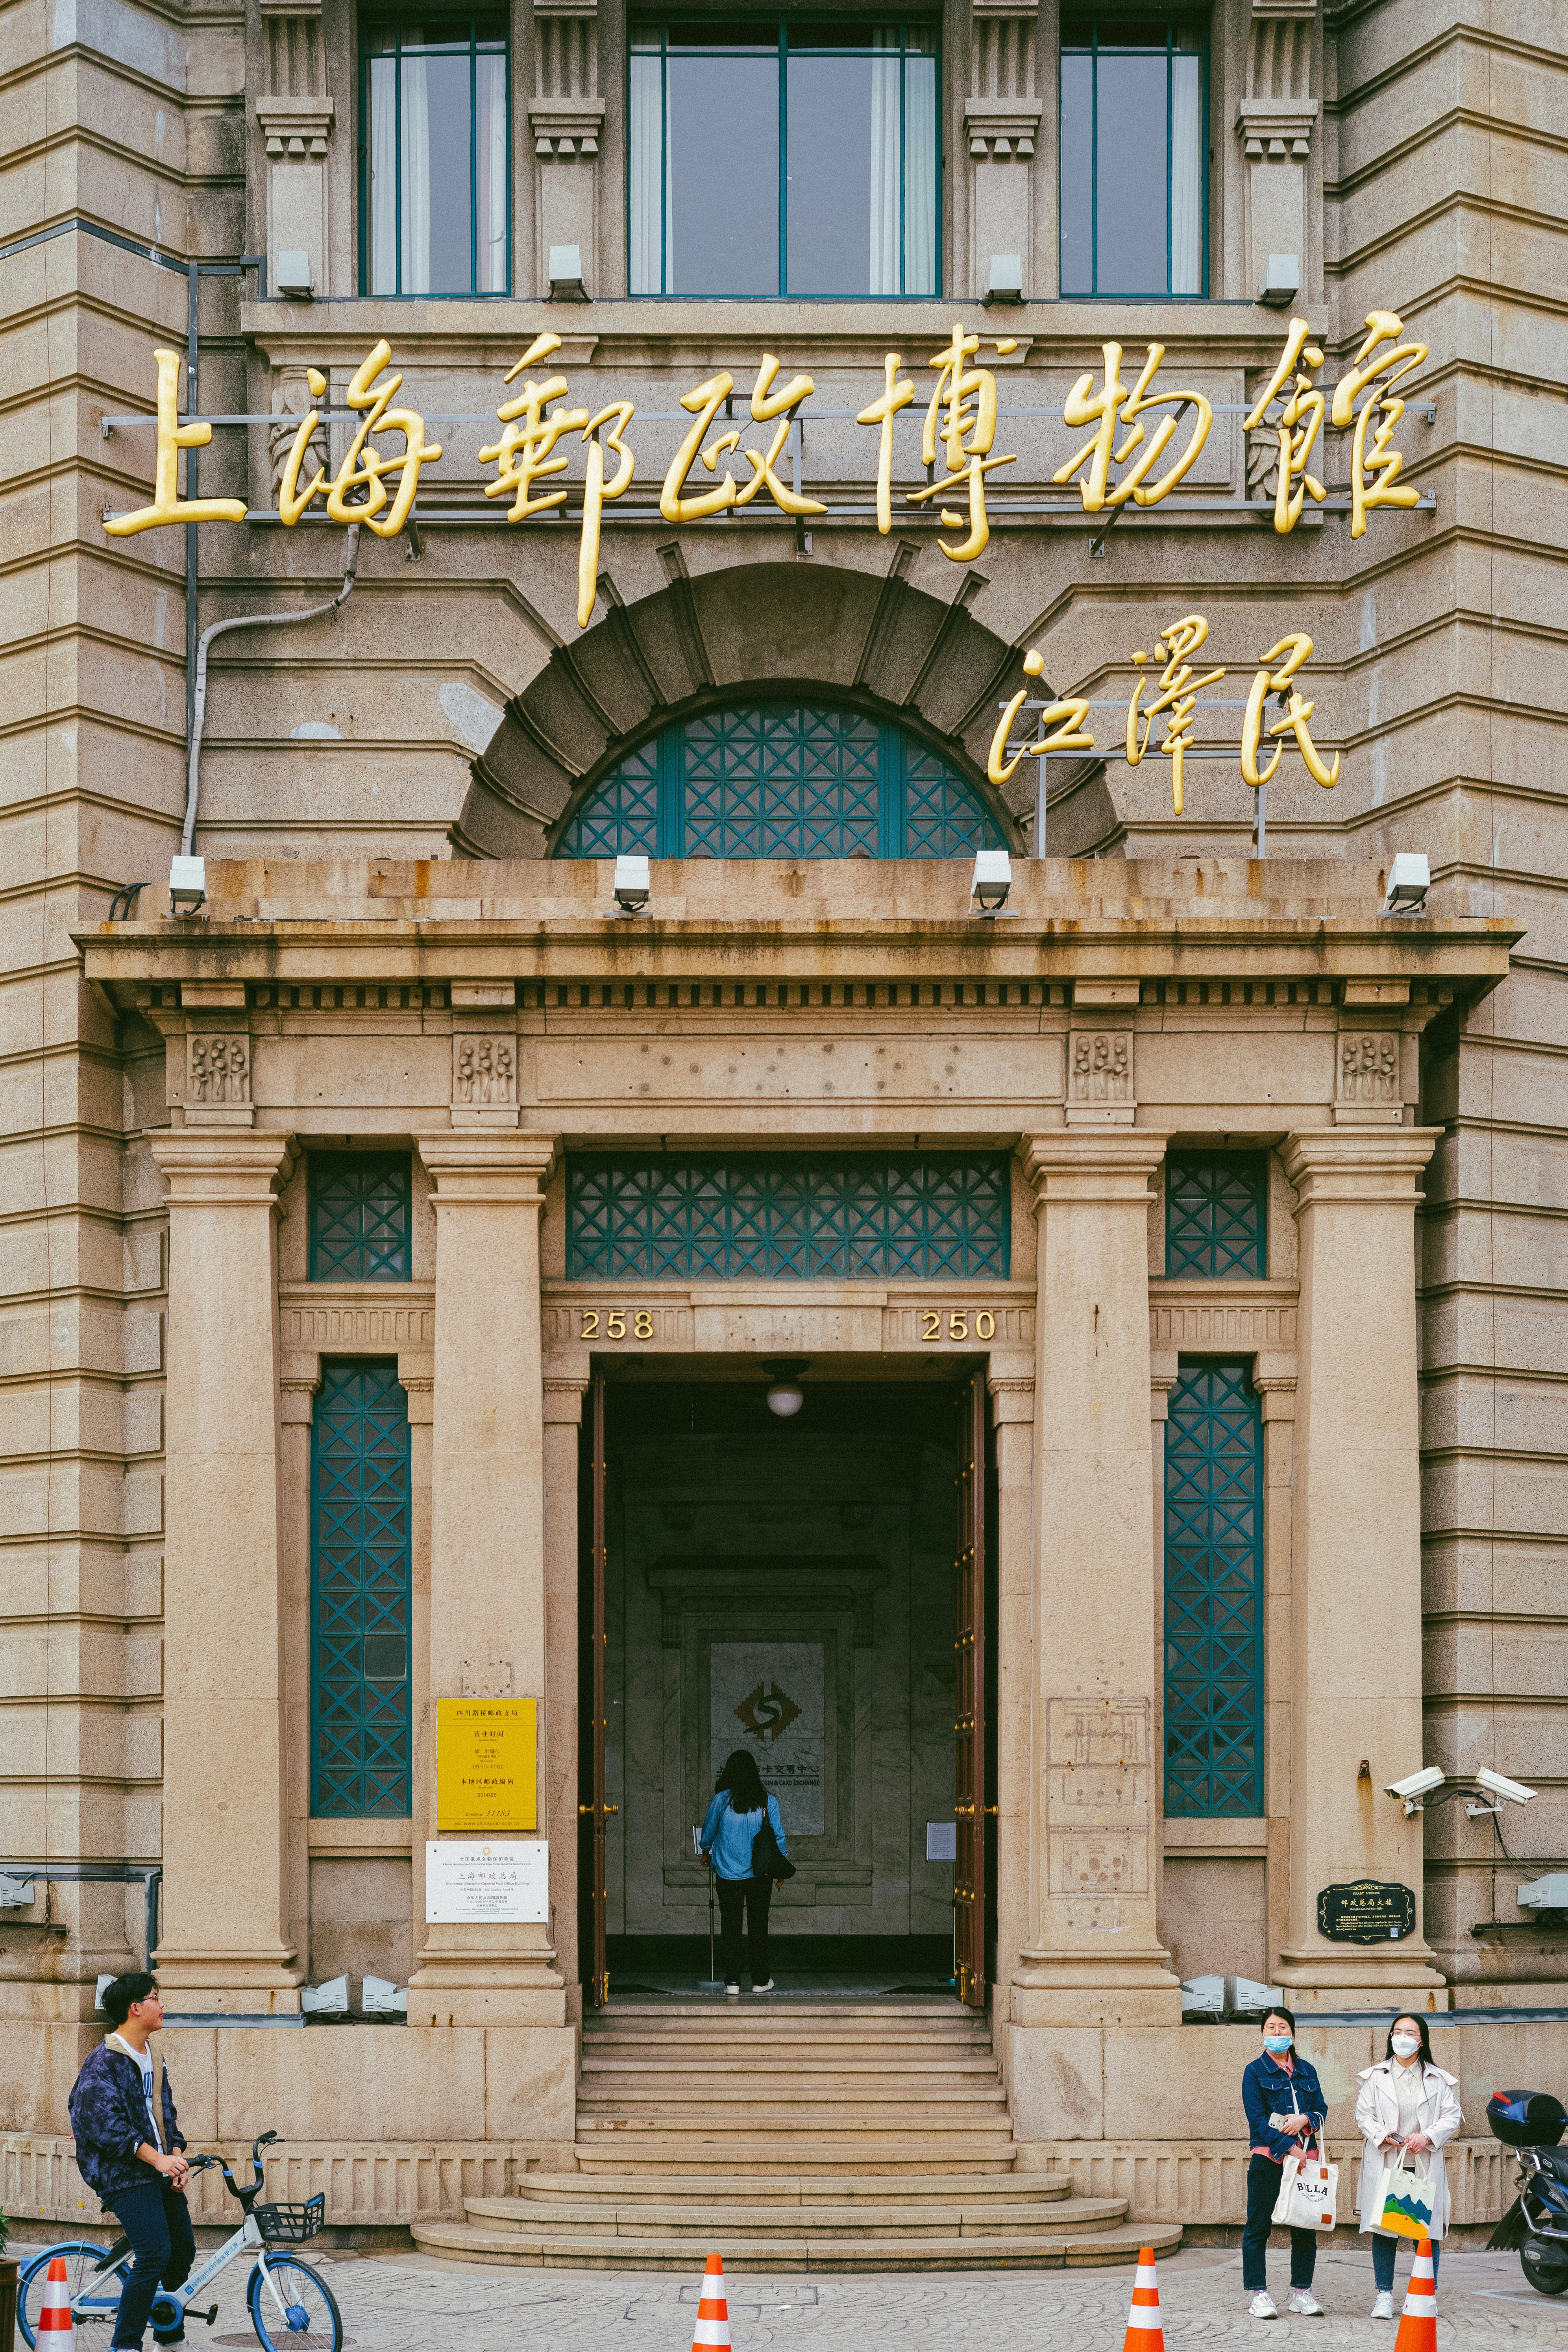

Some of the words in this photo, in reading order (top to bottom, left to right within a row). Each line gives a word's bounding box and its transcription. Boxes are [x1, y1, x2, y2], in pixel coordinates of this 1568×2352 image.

[581, 1311, 654, 1339] 258
[922, 1311, 995, 1340] 250
[1341, 1898, 1393, 1907] 邮政总局大楼
